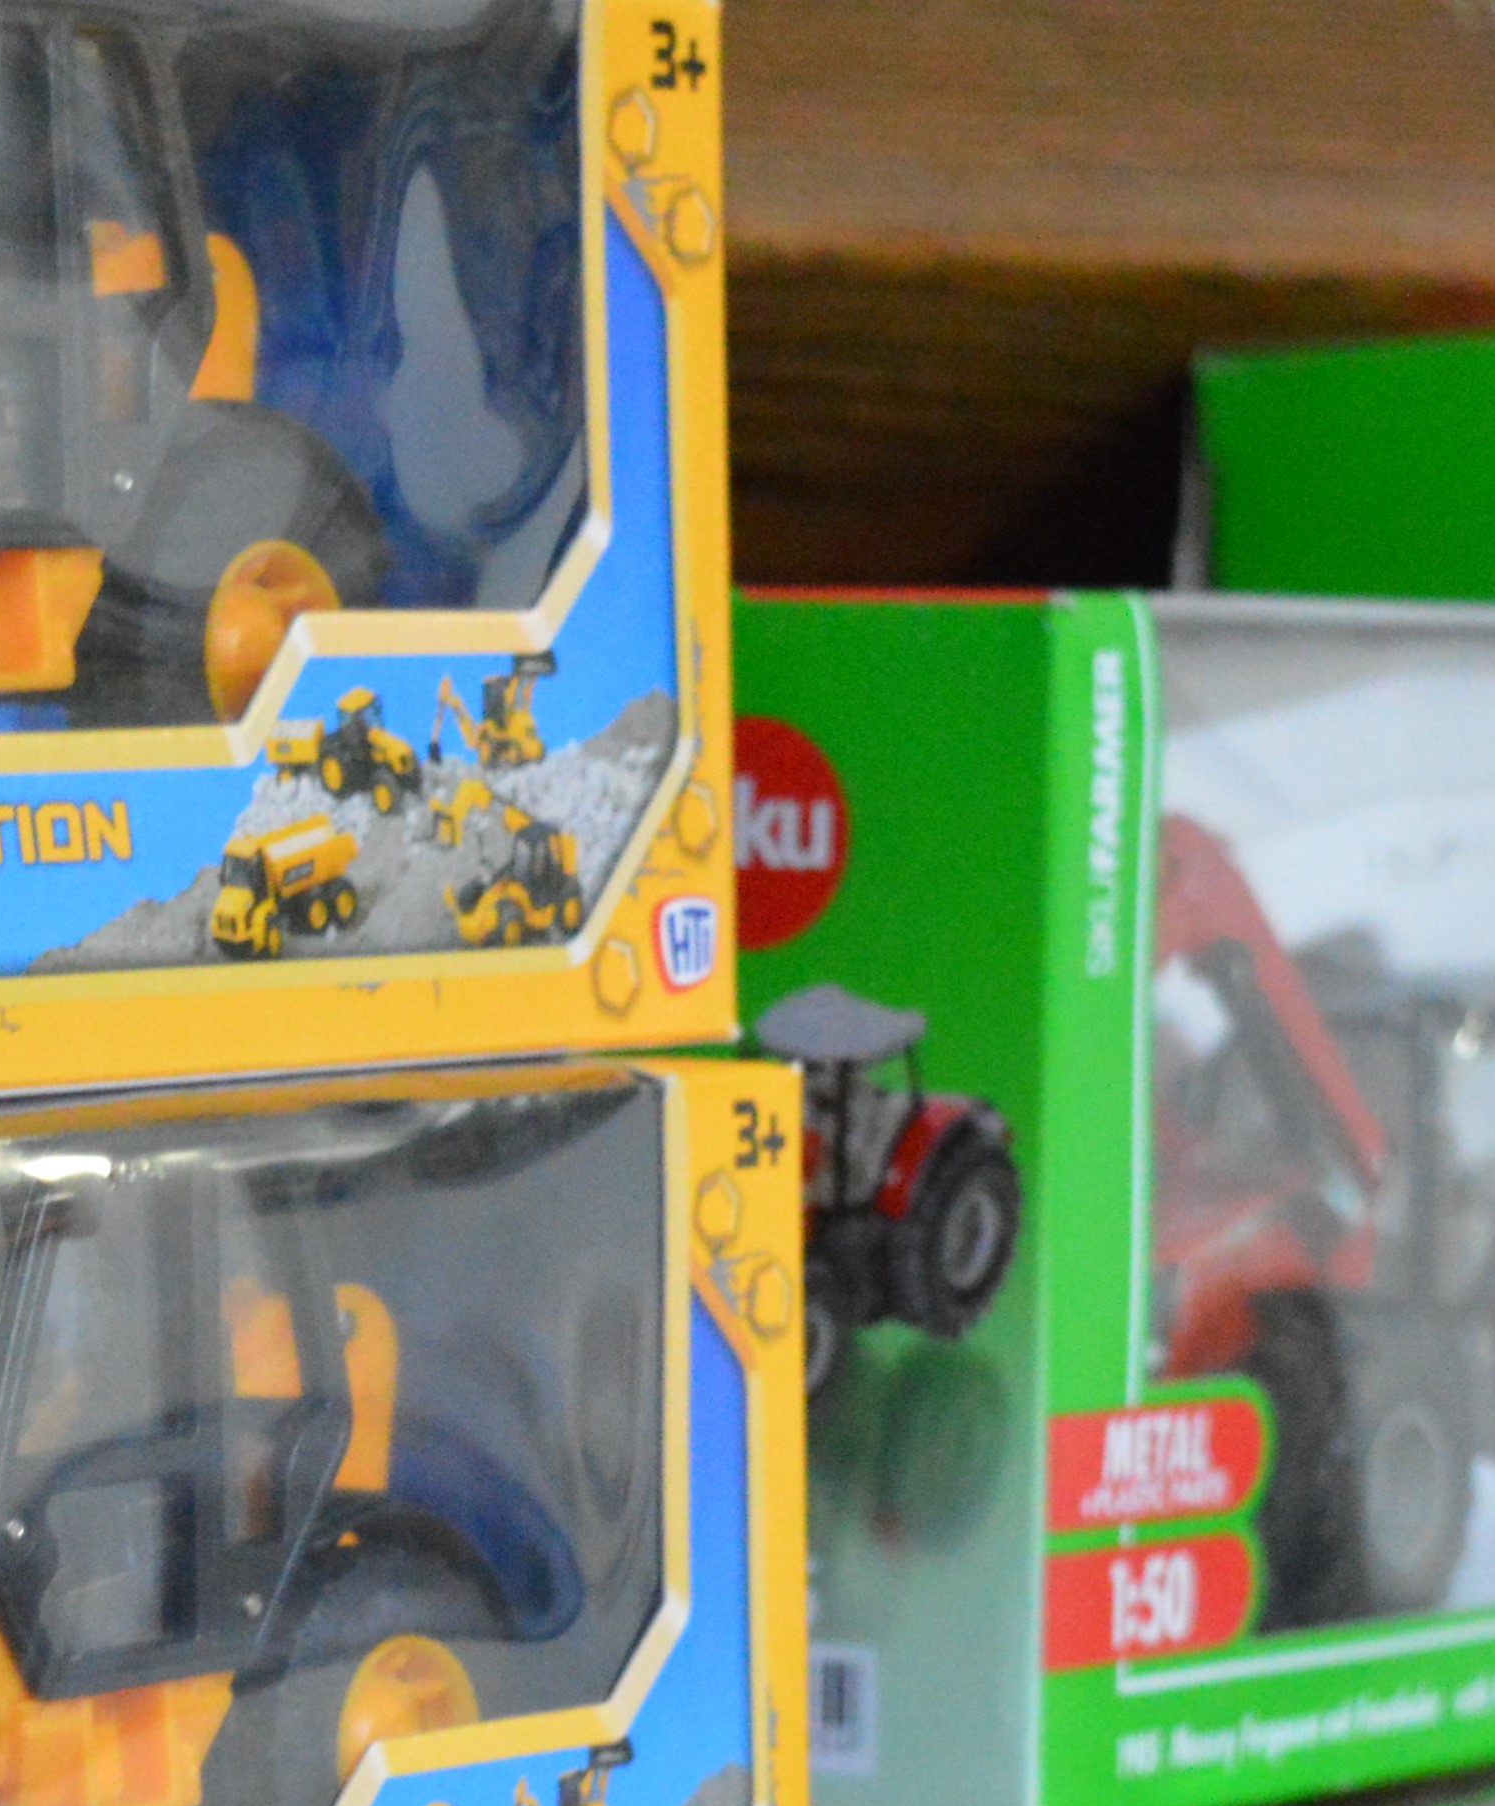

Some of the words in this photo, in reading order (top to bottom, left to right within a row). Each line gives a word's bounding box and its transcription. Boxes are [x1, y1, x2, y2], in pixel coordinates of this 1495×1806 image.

[650, 20, 707, 92] 3+
[733, 774, 835, 870] ku
[733, 1100, 786, 1168] 3+
[1102, 1408, 1216, 1482] METAL
[1108, 1549, 1198, 1651] 1:50
